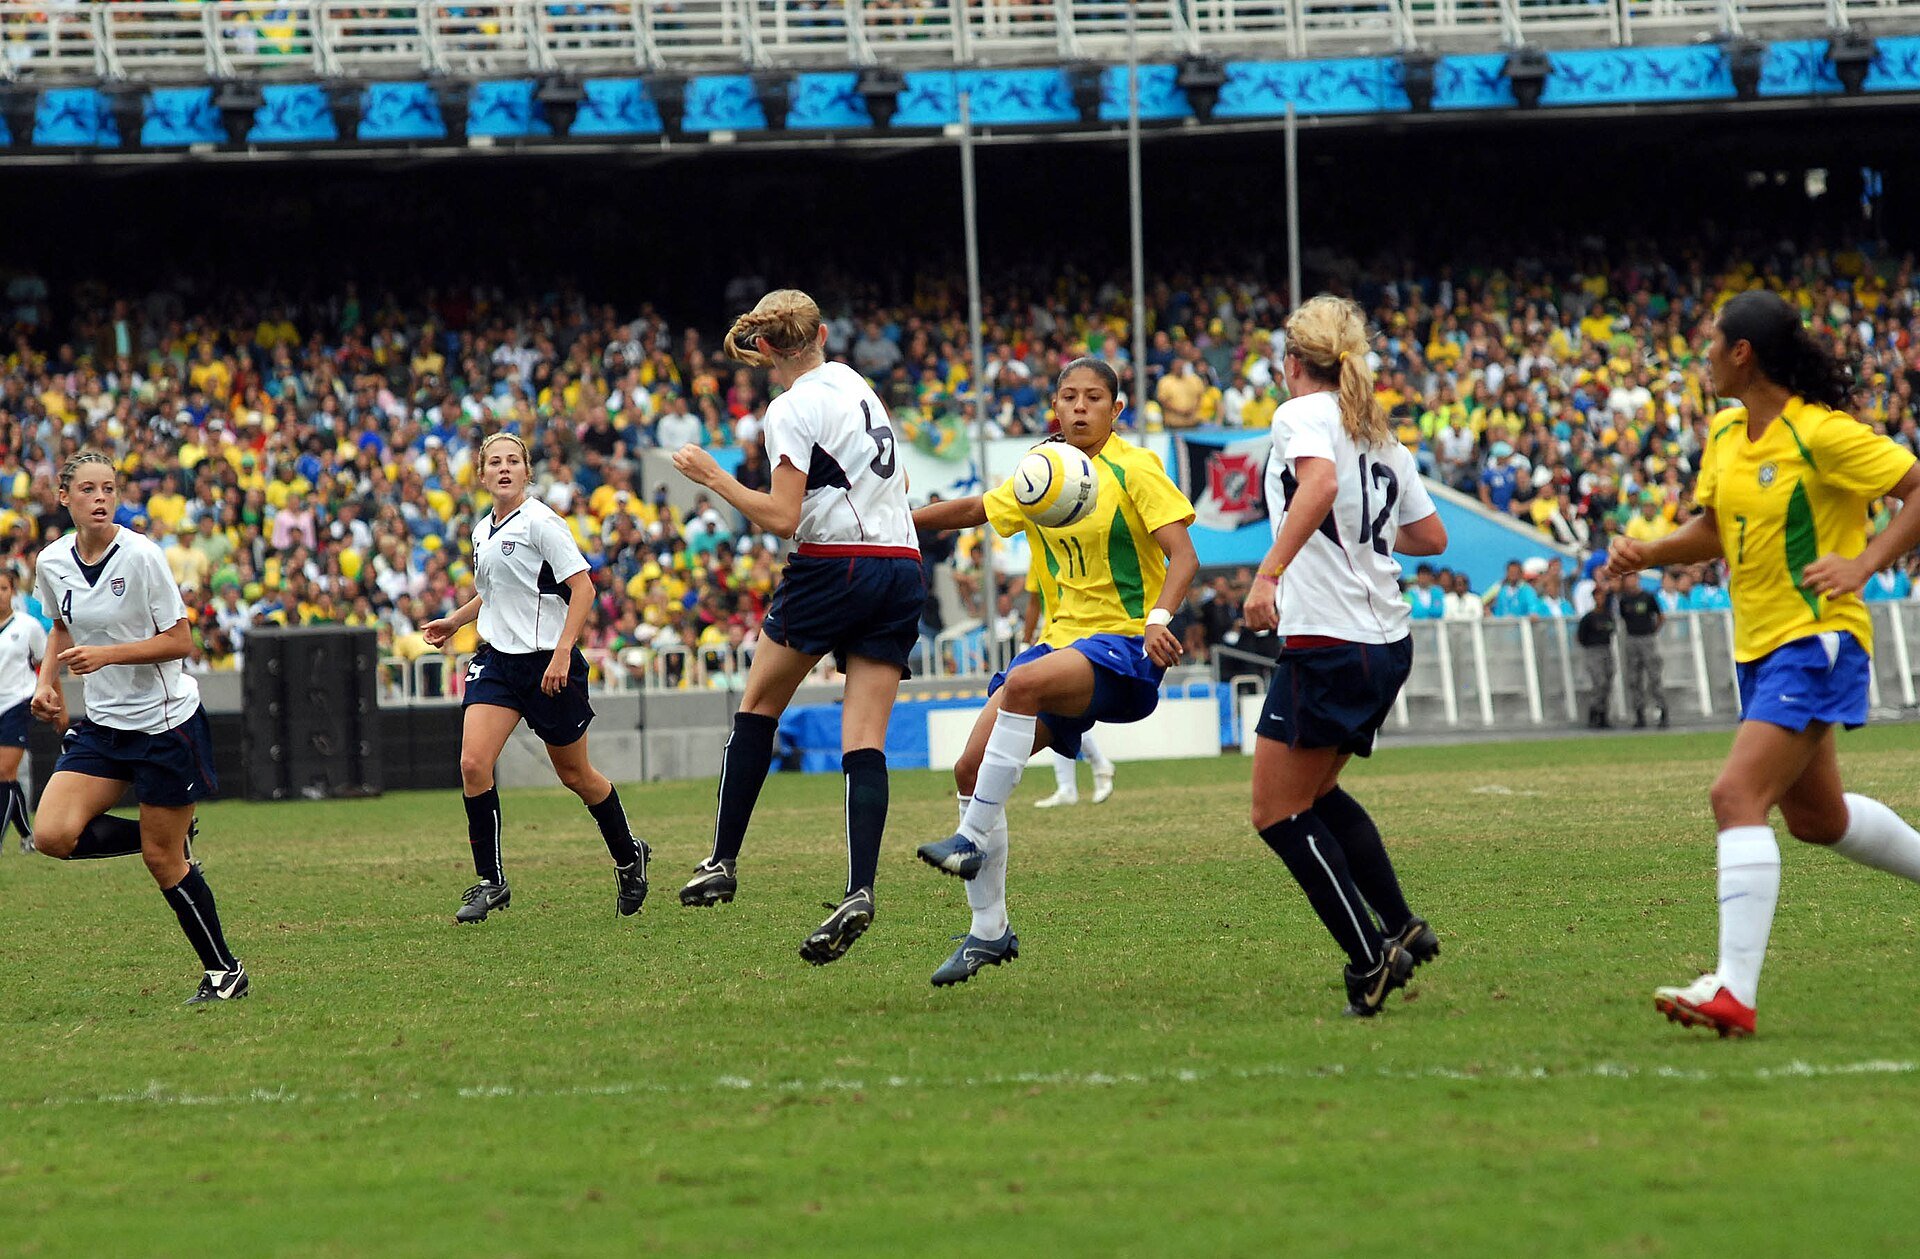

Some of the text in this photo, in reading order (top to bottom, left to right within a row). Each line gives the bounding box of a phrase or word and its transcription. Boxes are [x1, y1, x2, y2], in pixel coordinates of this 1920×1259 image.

[860, 399, 895, 480] 6
[1359, 453, 1399, 557] 12
[1059, 536, 1086, 579] 11
[1734, 515, 1747, 564] 7
[61, 589, 73, 624] 4
